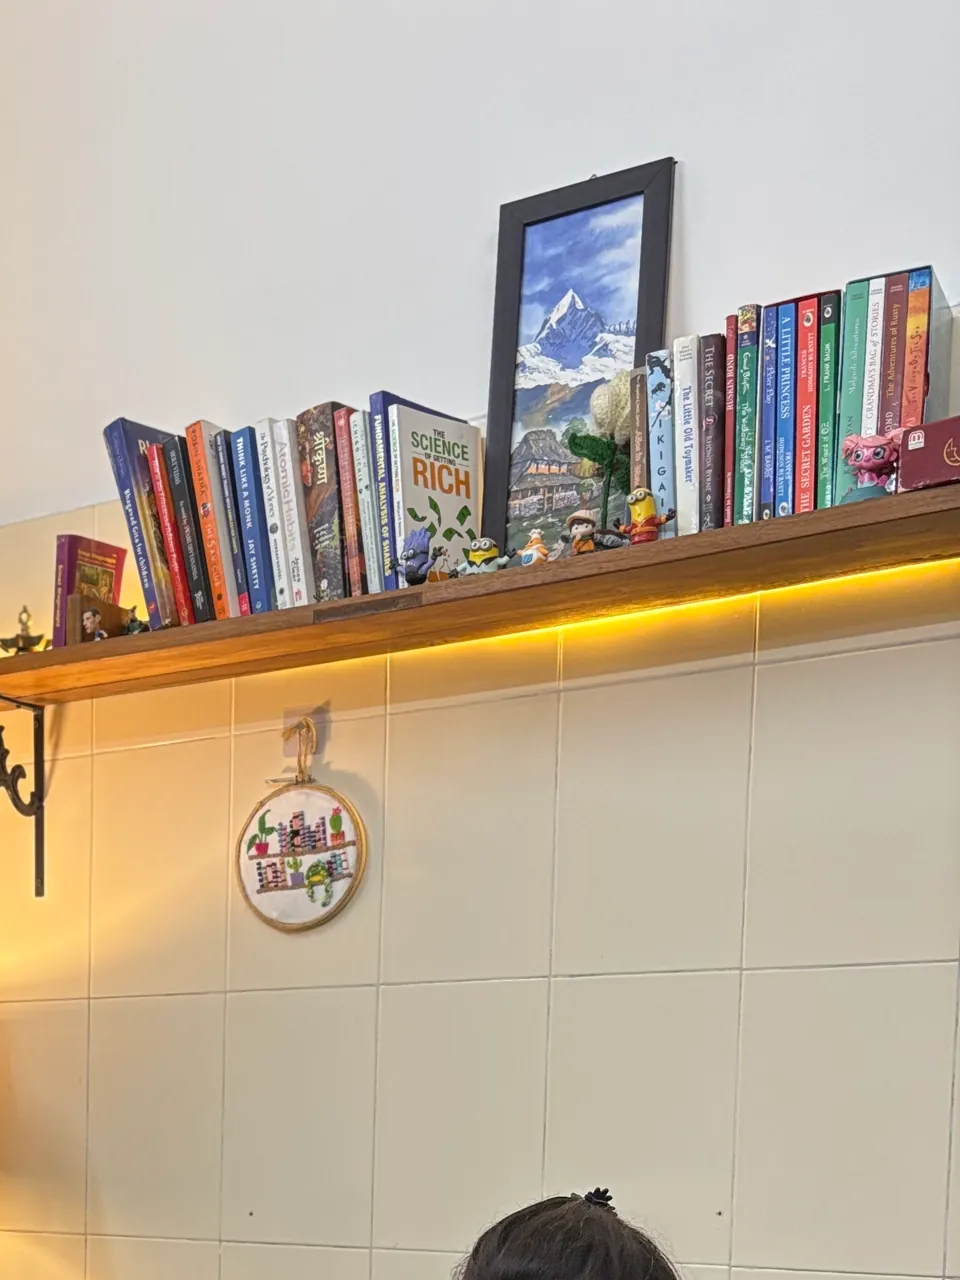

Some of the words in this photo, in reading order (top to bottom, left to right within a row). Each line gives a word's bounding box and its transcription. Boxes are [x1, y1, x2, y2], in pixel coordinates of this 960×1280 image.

[781, 316, 791, 324] A
[870, 301, 880, 337] STORIES
[890, 303, 900, 326] Rusty
[706, 346, 715, 368] THE
[781, 327, 791, 366] LITTLE
[823, 342, 831, 362] BAUM
[868, 348, 877, 366] BAG
[887, 333, 897, 381] Adventures
[726, 353, 735, 377] BOND
[766, 366, 776, 387] Peter
[823, 363, 831, 384] FRANK
[682, 386, 692, 401] The
[705, 370, 714, 407] SECRET
[726, 379, 734, 411] RUSKIN
[766, 388, 775, 404] Pan
[780, 367, 791, 419] PRINCESS
[866, 366, 876, 420] GRANDMA'S
[886, 382, 895, 397] The
[682, 403, 692, 425] Little
[802, 404, 812, 447] GARDEN
[352, 419, 360, 453] ICHIGO
[374, 414, 385, 480] FUNDAMENTAL
[411, 431, 469, 461] SCIENCE
[432, 428, 446, 439] THE
[683, 427, 693, 442] Old
[190, 427, 200, 457] ROBIN
[195, 459, 206, 495] SHARMA
[236, 436, 246, 465] THINK
[432, 455, 456, 466] GETTING
[656, 419, 667, 507] IKIGAI
[682, 443, 693, 484] Toymaker
[239, 468, 248, 489] LIKE
[260, 441, 271, 485] Psychology
[266, 489, 275, 519] Money
[276, 441, 291, 498] Atomic
[412, 457, 470, 499] RICH
[800, 449, 811, 488] SECRET
[123, 488, 138, 526] Bhagavad
[243, 500, 253, 530] MONK
[378, 482, 388, 525] ANALYSIS
[800, 491, 810, 512] THE
[132, 526, 143, 543] Gita
[283, 500, 297, 552] Habits
[381, 526, 389, 540] OF
[135, 543, 143, 555] for
[204, 523, 213, 537] THE
[212, 566, 221, 587] CLUB
[247, 539, 256, 555] JAY
[138, 556, 149, 589] children
[250, 557, 260, 589] SHETTY
